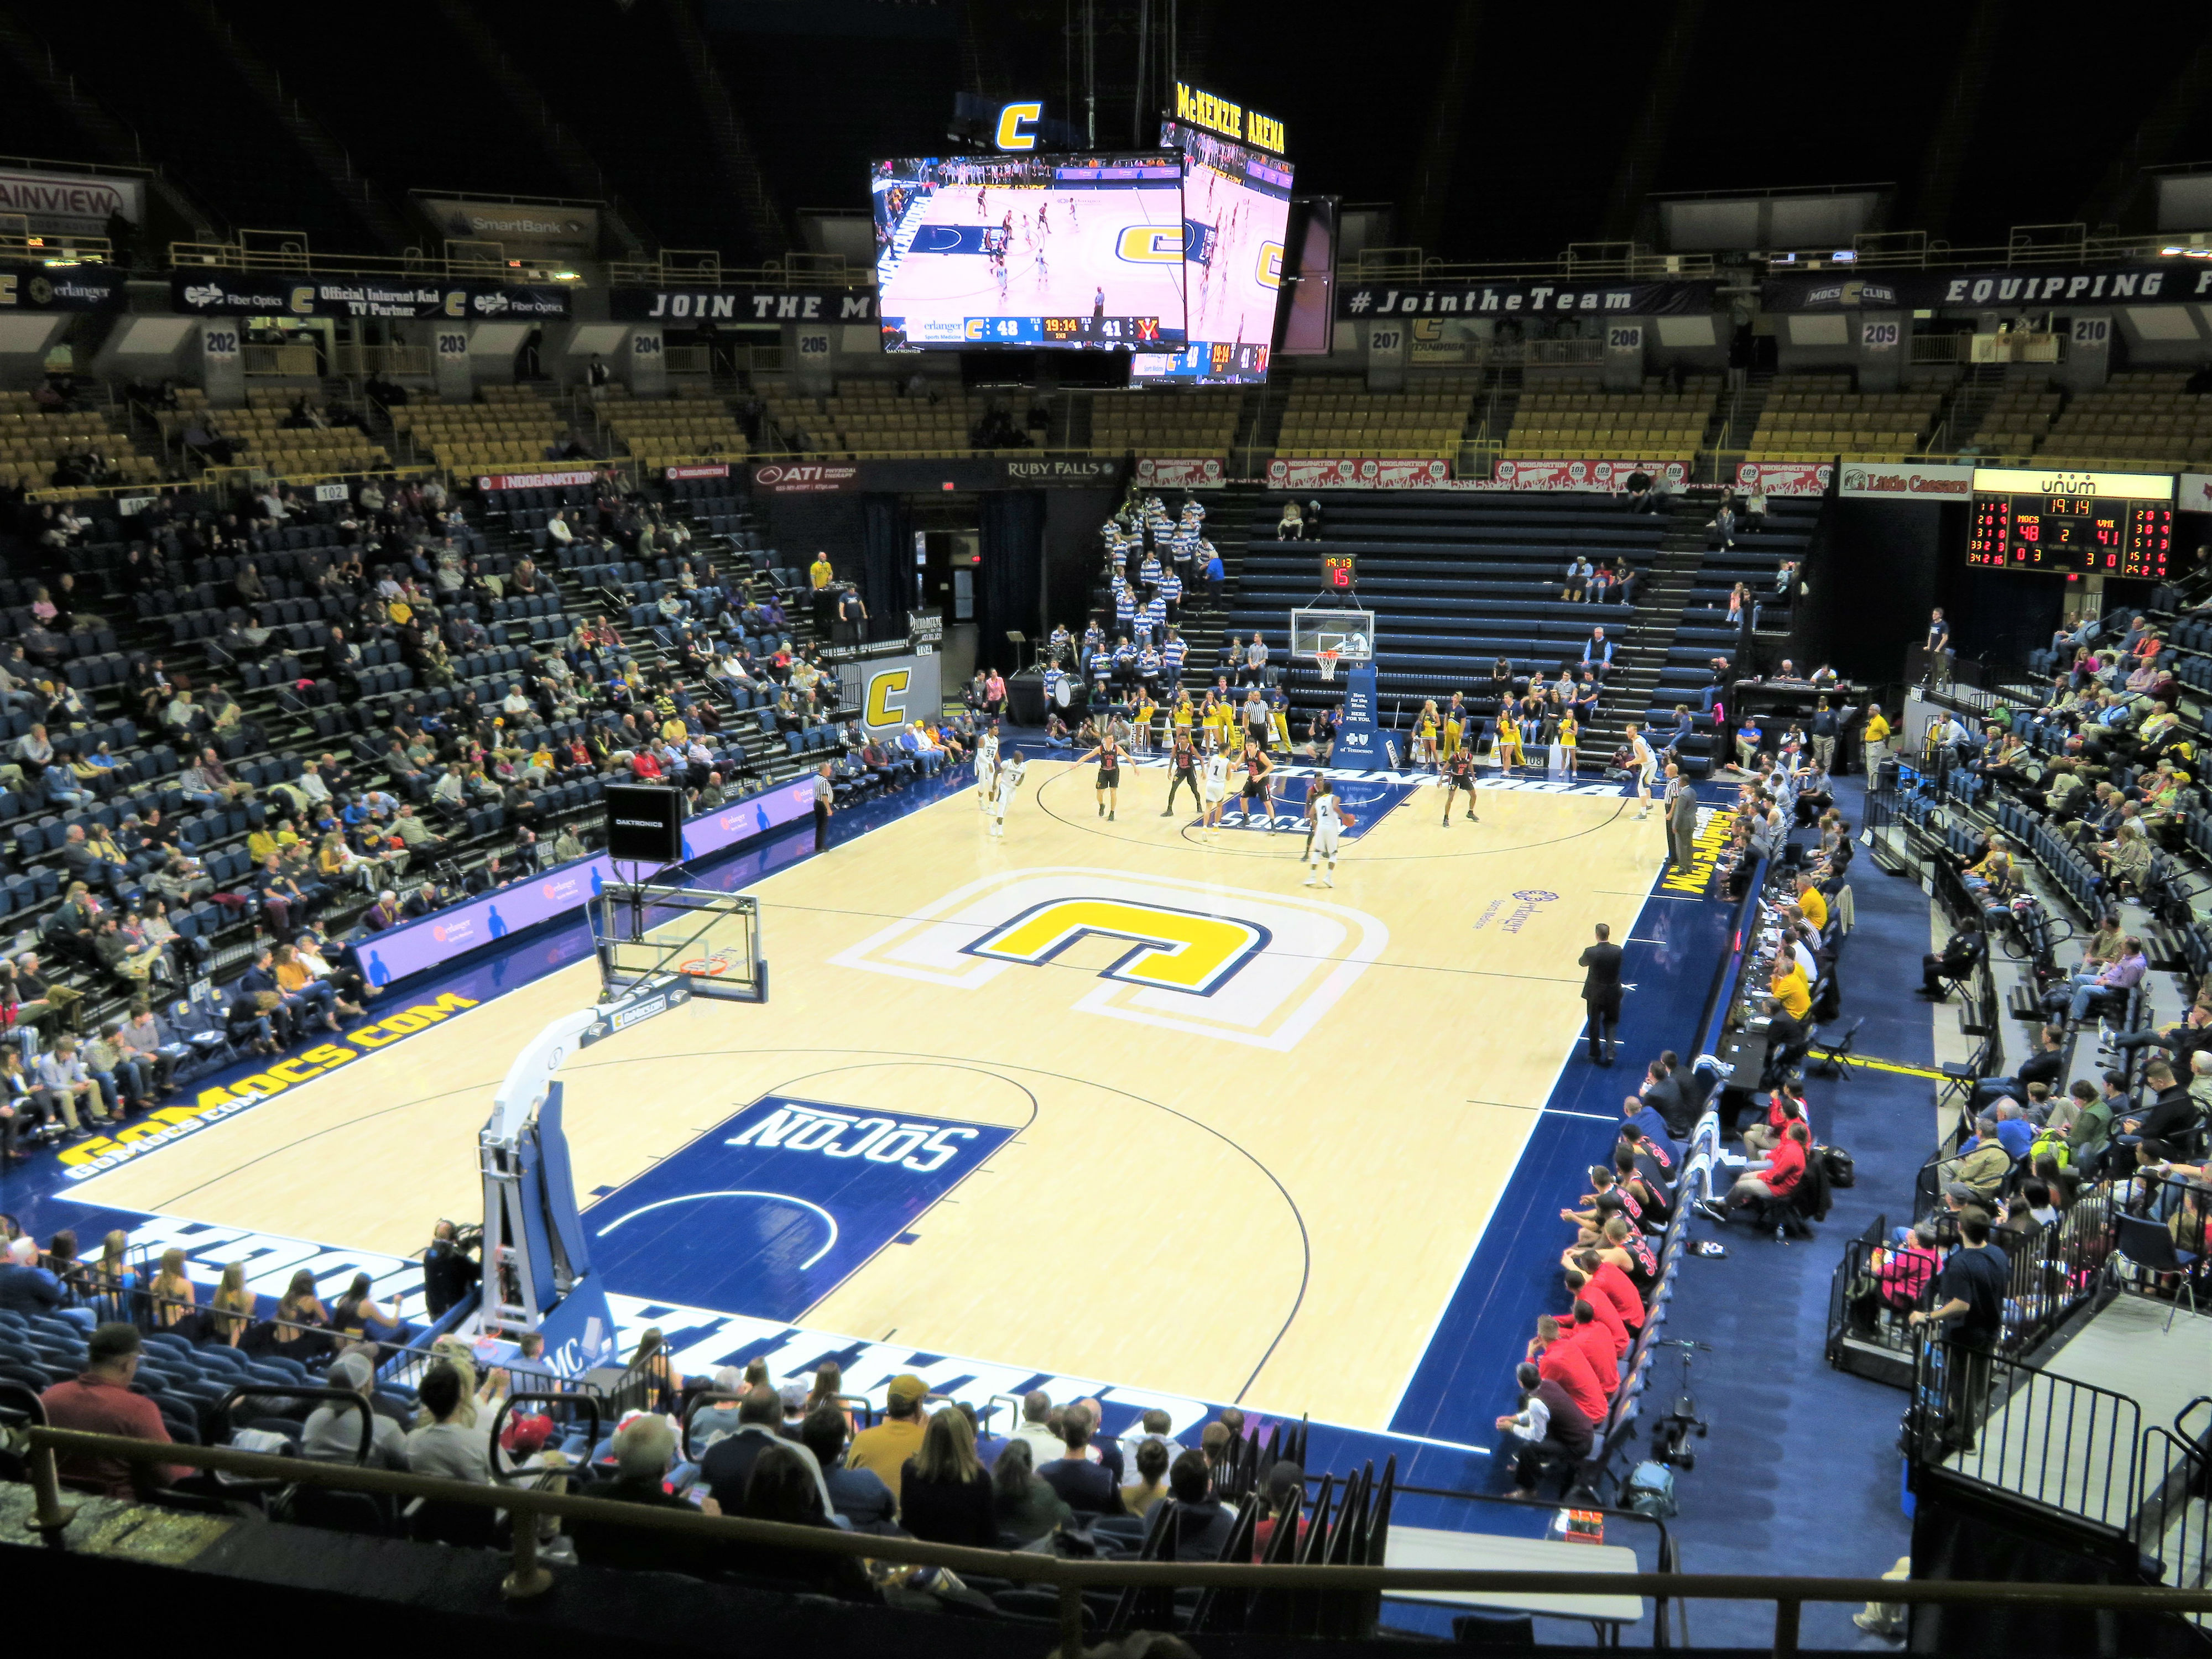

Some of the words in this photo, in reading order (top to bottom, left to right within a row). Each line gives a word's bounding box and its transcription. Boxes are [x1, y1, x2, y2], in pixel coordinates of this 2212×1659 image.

[1176, 81, 1242, 139] McKENZIE
[1248, 111, 1285, 155] ARENA
[995, 102, 1044, 151] C
[473, 217, 562, 234] SmartBank
[54, 281, 111, 303] erlanger
[1945, 272, 2164, 302] EQUIPPING
[227, 294, 251, 305] Fiber
[252, 295, 283, 309] Optics
[321, 286, 364, 300] Official
[367, 288, 414, 302] Internet
[417, 289, 440, 303] And
[1809, 288, 1841, 302] MOCS
[1863, 288, 1892, 300] CLUB
[348, 302, 367, 315] TV
[370, 302, 416, 316] Partner
[511, 301, 534, 312] Fiber
[534, 302, 564, 314] Optics
[649, 294, 735, 317] JOIN
[753, 296, 822, 319] THE
[841, 296, 878, 319] M
[924, 320, 962, 332] erlanger
[997, 320, 1019, 336] 48
[1045, 319, 1078, 332] 19:14
[1102, 320, 1122, 337] 41
[2075, 321, 2106, 341] 210
[1373, 332, 1400, 349] 207
[1610, 329, 1640, 346] 208
[1865, 325, 1897, 343] 209
[207, 332, 237, 352] 202
[440, 335, 466, 353] 203
[635, 336, 660, 353] 204
[801, 336, 828, 353] 205
[1187, 346, 1199, 368] 48
[1212, 345, 1230, 363] 19:14
[1240, 347, 1251, 369] 41
[783, 467, 822, 481] ATI
[1008, 462, 1051, 478] RUBY
[1055, 463, 1100, 476] FALLS
[1866, 474, 1907, 492] Little
[1908, 476, 1968, 493] Caesars
[324, 487, 343, 501] 102
[1989, 503, 1995, 512] 1
[2000, 503, 2008, 514] 5
[2052, 498, 2090, 515] 19:14
[1977, 515, 1984, 525] 2
[1985, 515, 1994, 525] 0
[1999, 515, 2007, 525] 9
[2017, 515, 2041, 524] MOCS
[2136, 510, 2144, 520] 2
[2146, 509, 2155, 521] 0
[2163, 511, 2171, 521] 7
[2096, 519, 2115, 529] VMI
[2135, 523, 2143, 534] 3
[2144, 524, 2153, 535] 0
[2161, 525, 2170, 535] 9
[1976, 528, 1984, 538] 3
[1987, 529, 1993, 538] 1
[1997, 529, 2006, 540] 8
[2019, 525, 2040, 542] 48
[2060, 529, 2070, 542] 2
[2097, 530, 2119, 545] 41
[1970, 540, 1983, 550] 33
[1983, 540, 1992, 551] 2
[1997, 541, 2006, 552] 3
[2134, 537, 2141, 548] 5
[2146, 539, 2152, 548] 1
[2159, 539, 2168, 550] 3
[1969, 553, 1982, 562] 34
[1982, 554, 1991, 564] 2
[1992, 555, 2005, 565] 16
[2016, 547, 2026, 561] 0
[2033, 549, 2042, 562] 3
[2086, 552, 2095, 565] 3
[2106, 554, 2117, 567] 0
[2130, 551, 2140, 562] 15
[2145, 552, 2151, 562] 1
[2158, 552, 2167, 564] 6
[1326, 557, 1353, 568] 19:13
[1333, 567, 1349, 586] 15
[2125, 564, 2139, 574] 25
[2141, 565, 2150, 576] 2
[2157, 567, 2167, 576] 4
[918, 646, 931, 655] 104
[863, 666, 911, 731] C
[986, 749, 994, 759] 34
[1387, 742, 1399, 765] FIGHT
[1213, 766, 1219, 776] 1
[1321, 806, 1328, 817] 2
[616, 819, 664, 828] DAKTRONICS
[728, 813, 746, 826] erlanger
[554, 879, 576, 893] erlanger
[1497, 901, 1543, 933] erlanger
[446, 919, 471, 935] erlanger
[724, 1103, 980, 1172] SOCON
